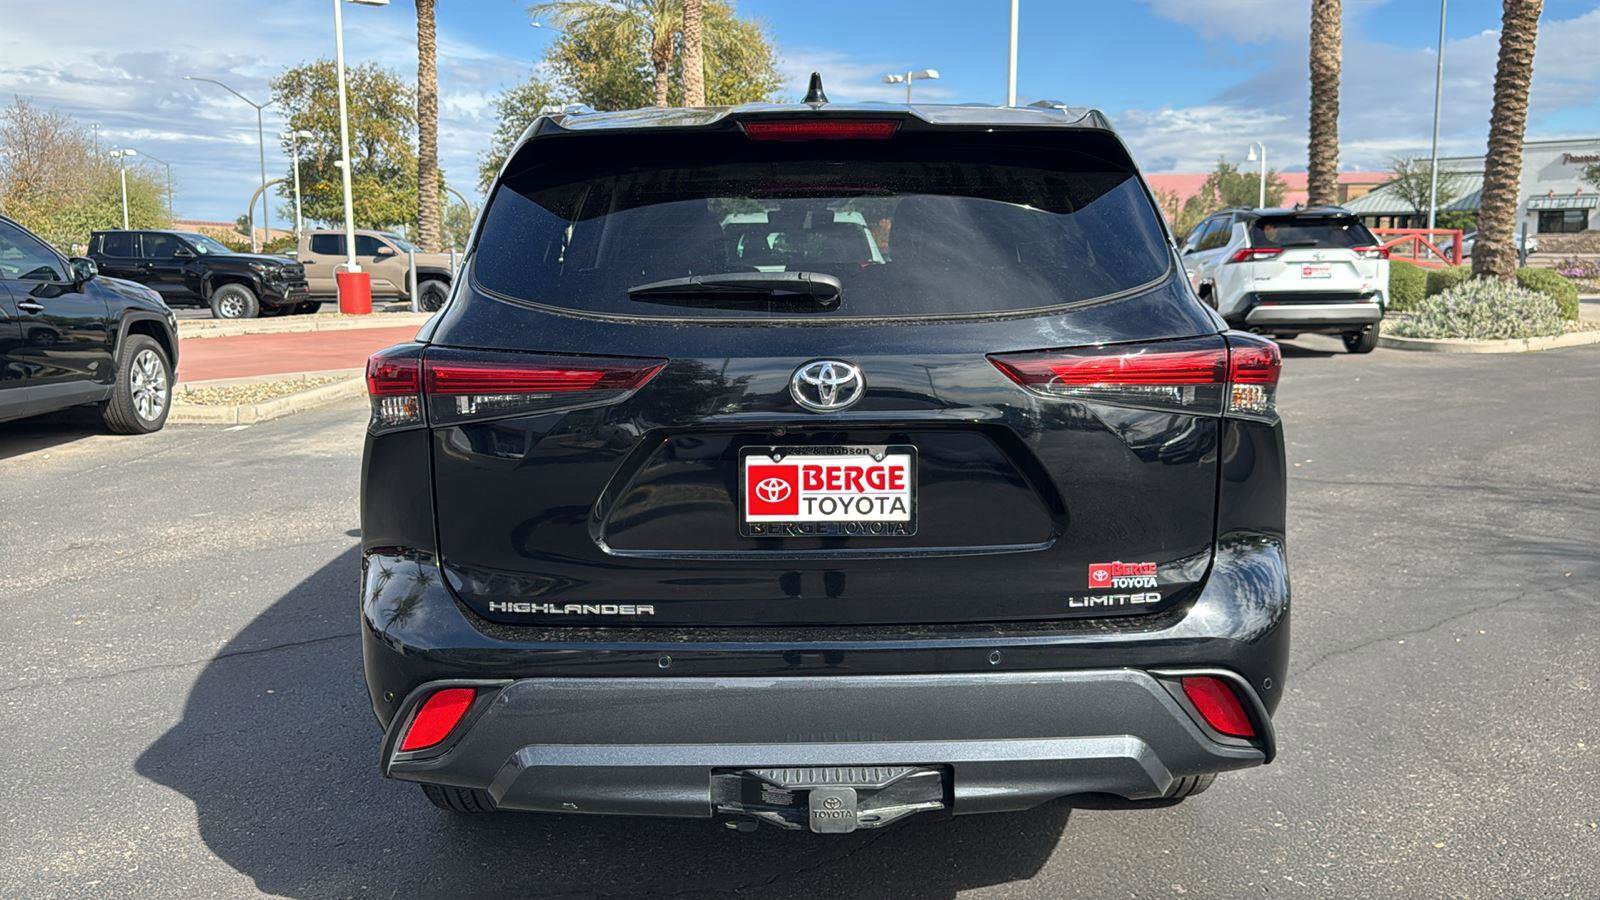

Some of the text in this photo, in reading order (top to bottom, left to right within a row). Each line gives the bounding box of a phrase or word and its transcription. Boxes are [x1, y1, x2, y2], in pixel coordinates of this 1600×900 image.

[826, 446, 870, 455] Dobson
[802, 464, 905, 493] BERGE
[802, 496, 907, 515] TOYOTA
[750, 521, 909, 536] BERGE TOYOTA
[1111, 561, 1157, 576] BERGE
[1111, 577, 1158, 588] TOYOTA
[1068, 592, 1162, 608] LIMITED
[489, 601, 655, 615] HIGHLANDER
[813, 810, 853, 819] TOYOTA
